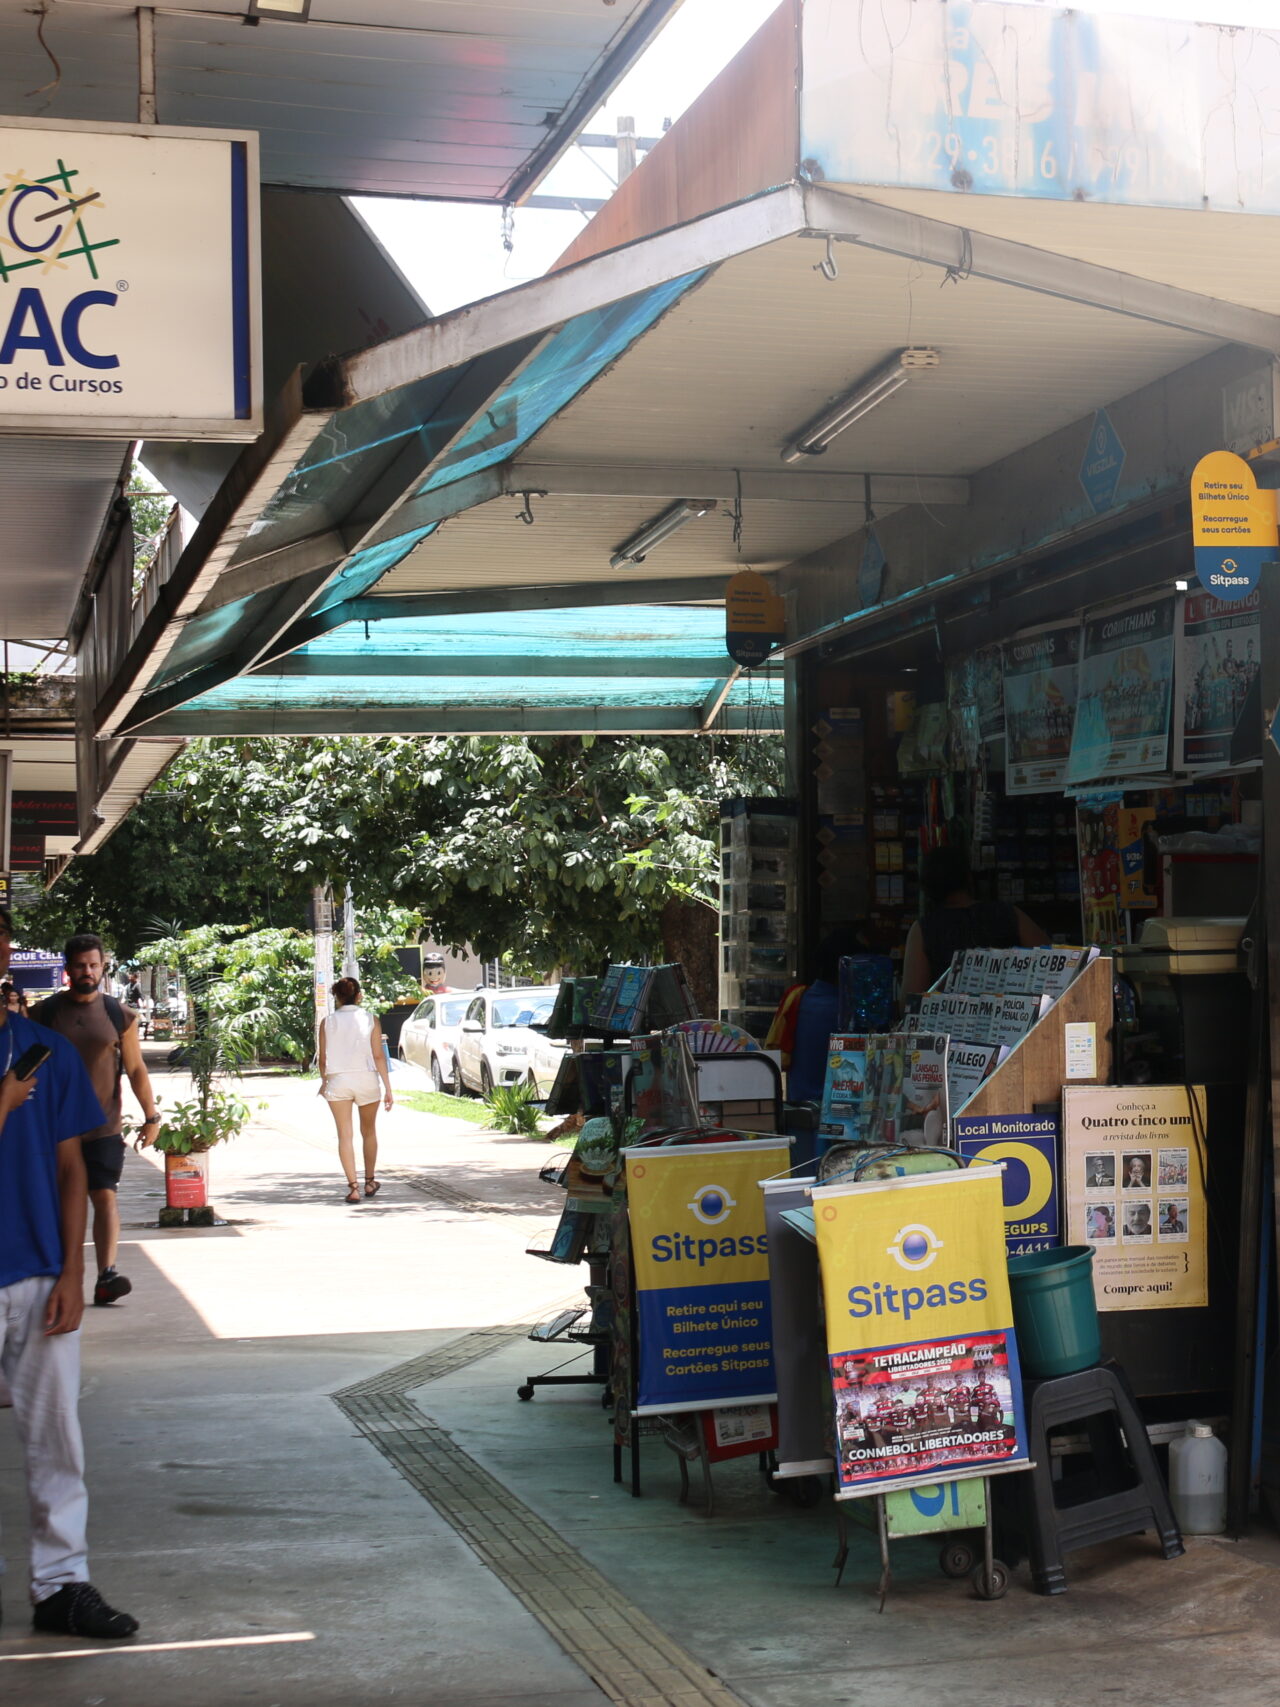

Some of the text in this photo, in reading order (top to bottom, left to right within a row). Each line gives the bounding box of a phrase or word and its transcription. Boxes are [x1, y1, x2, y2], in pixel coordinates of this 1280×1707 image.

[0, 287, 120, 370] AC
[16, 372, 123, 393] de Cursos
[1204, 481, 1228, 490] Retire
[1198, 491, 1250, 501] Bilhete Único
[1202, 515, 1248, 524] Recarregue
[1221, 525, 1252, 534] cartões
[1210, 574, 1250, 588] Sitpass
[1101, 610, 1158, 639] CORINTHIANS
[39, 951, 64, 960] CELL
[1050, 954, 1068, 972] BB
[1003, 999, 1025, 1011] POLÍCIA
[1001, 1010, 1029, 1022] PENAL GO
[956, 1051, 986, 1068] ALEGO
[914, 1064, 939, 1074] CANSAÇO
[831, 1079, 865, 1091] ALERGIA
[911, 1073, 944, 1083] NAS PERNAS
[1116, 1102, 1149, 1113] Conheça
[958, 1119, 1056, 1136] Local Monitorado
[1081, 1112, 1192, 1129] Quatro cinco um
[1109, 1132, 1134, 1141] revista
[1134, 1132, 1147, 1141] dos
[1148, 1131, 1170, 1140] livros
[1003, 1222, 1048, 1237] EGUPS
[651, 1232, 769, 1267] Sitpass
[1103, 1281, 1173, 1296] Compre aqui!
[847, 1278, 988, 1321] Sitpass
[666, 1300, 764, 1317] Retire aqui seu
[672, 1315, 759, 1334] Bilhete Único
[662, 1341, 771, 1359] Recarregue seus
[872, 1342, 967, 1369] TETRACAMPEÃO
[665, 1358, 770, 1376] Cartões Sitpass
[887, 1359, 936, 1374] LIBERTADORES
[936, 1357, 953, 1366] 2025
[849, 1442, 919, 1461] CONMEBOL
[918, 1429, 1005, 1451] LIBERTADORES
